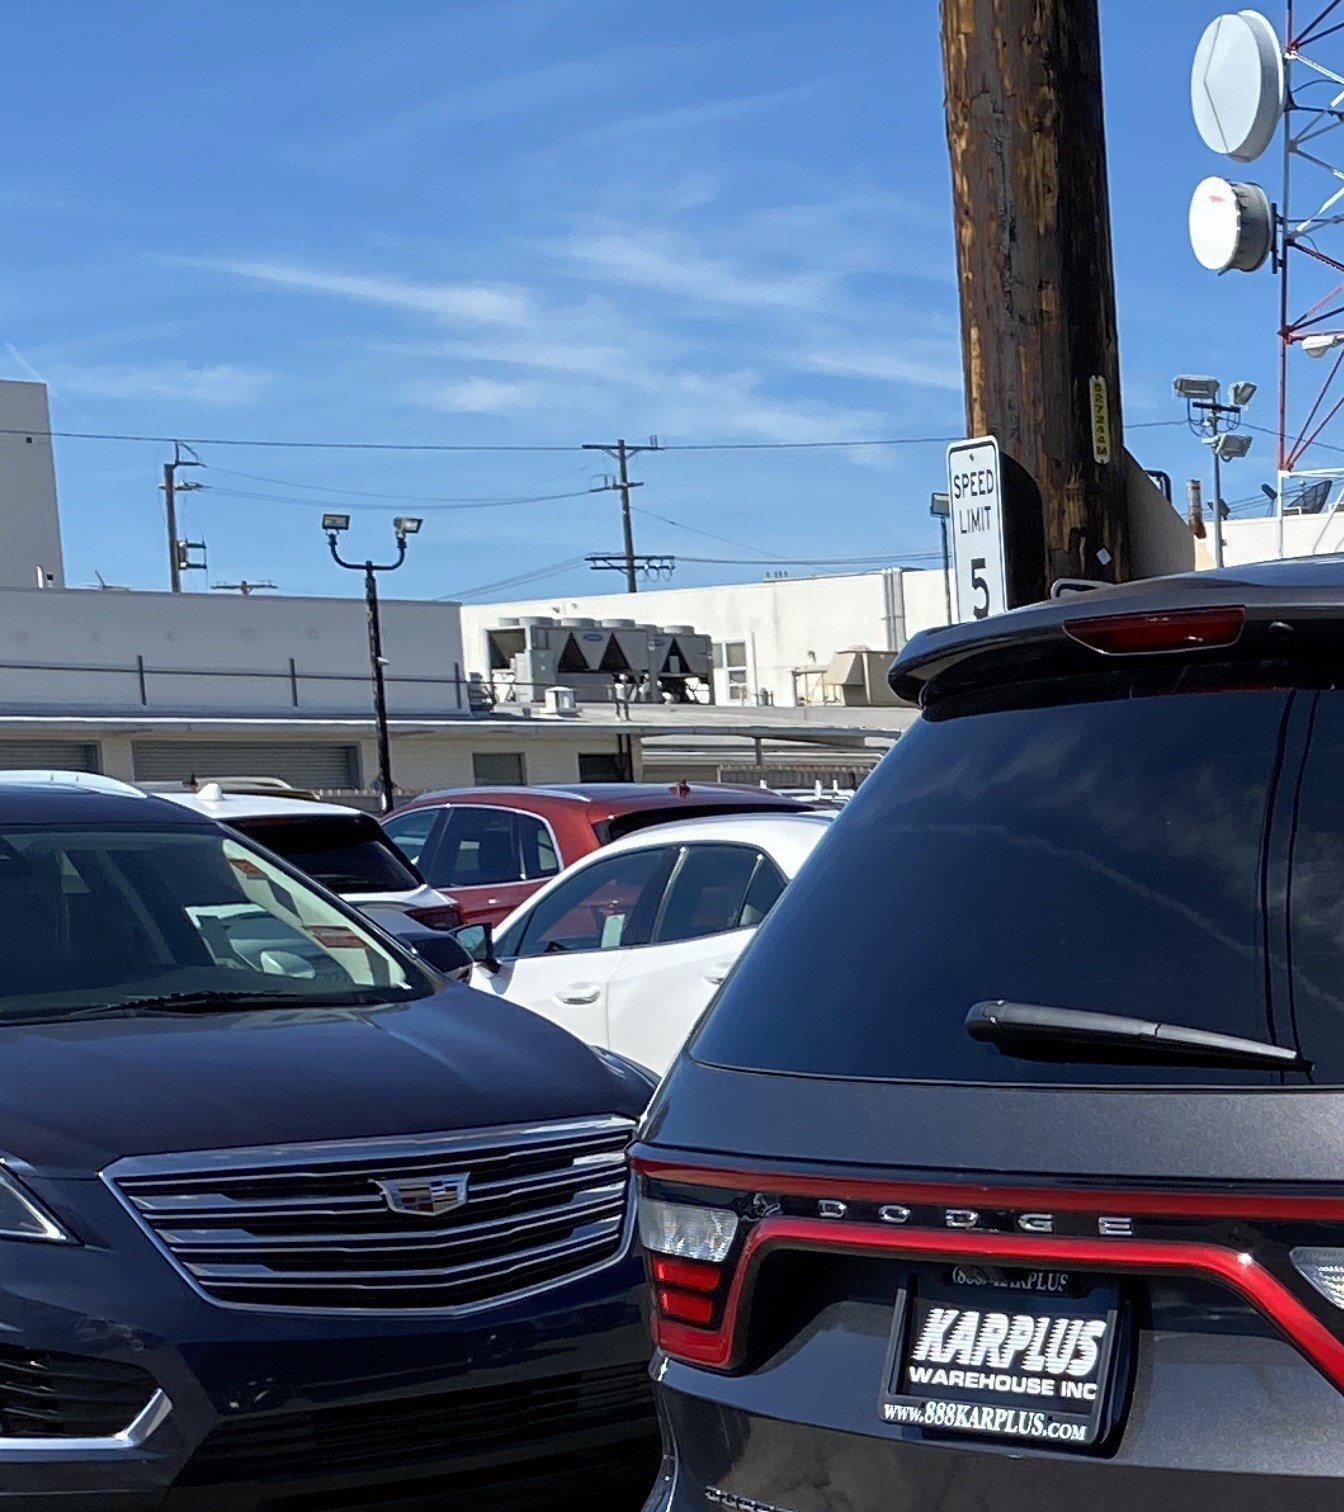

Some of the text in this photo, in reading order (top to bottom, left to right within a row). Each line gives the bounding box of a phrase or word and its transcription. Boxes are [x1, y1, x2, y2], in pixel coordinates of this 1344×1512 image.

[953, 468, 994, 499] SPEED
[959, 505, 992, 534] LIMIT
[970, 557, 990, 620] 5
[818, 1199, 1134, 1236] DODGE
[910, 1307, 1107, 1376] KARPLUS
[908, 1365, 1099, 1400] WAREHOUSE INC
